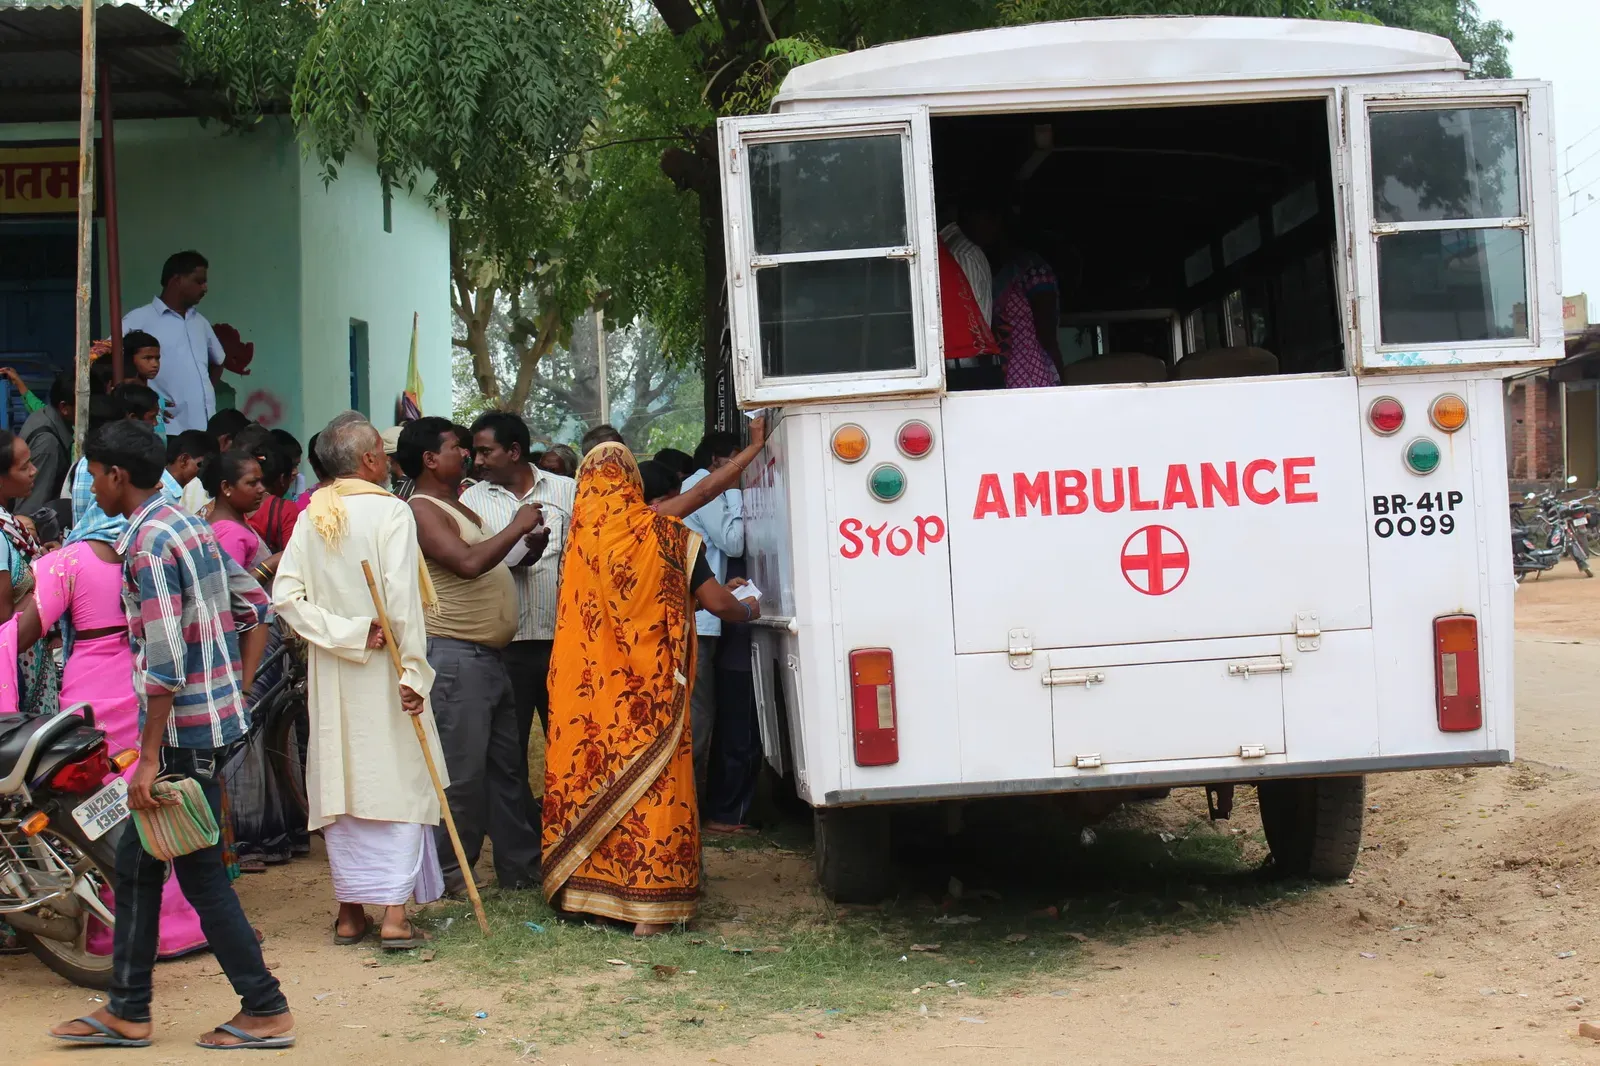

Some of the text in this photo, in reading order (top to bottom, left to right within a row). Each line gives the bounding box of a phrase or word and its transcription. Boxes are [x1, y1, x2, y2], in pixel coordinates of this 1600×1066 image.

[973, 457, 1319, 519] AMBULANCE
[1373, 491, 1463, 515] BR-41P
[1374, 514, 1455, 538] 0099
[96, 803, 126, 830] 1386
